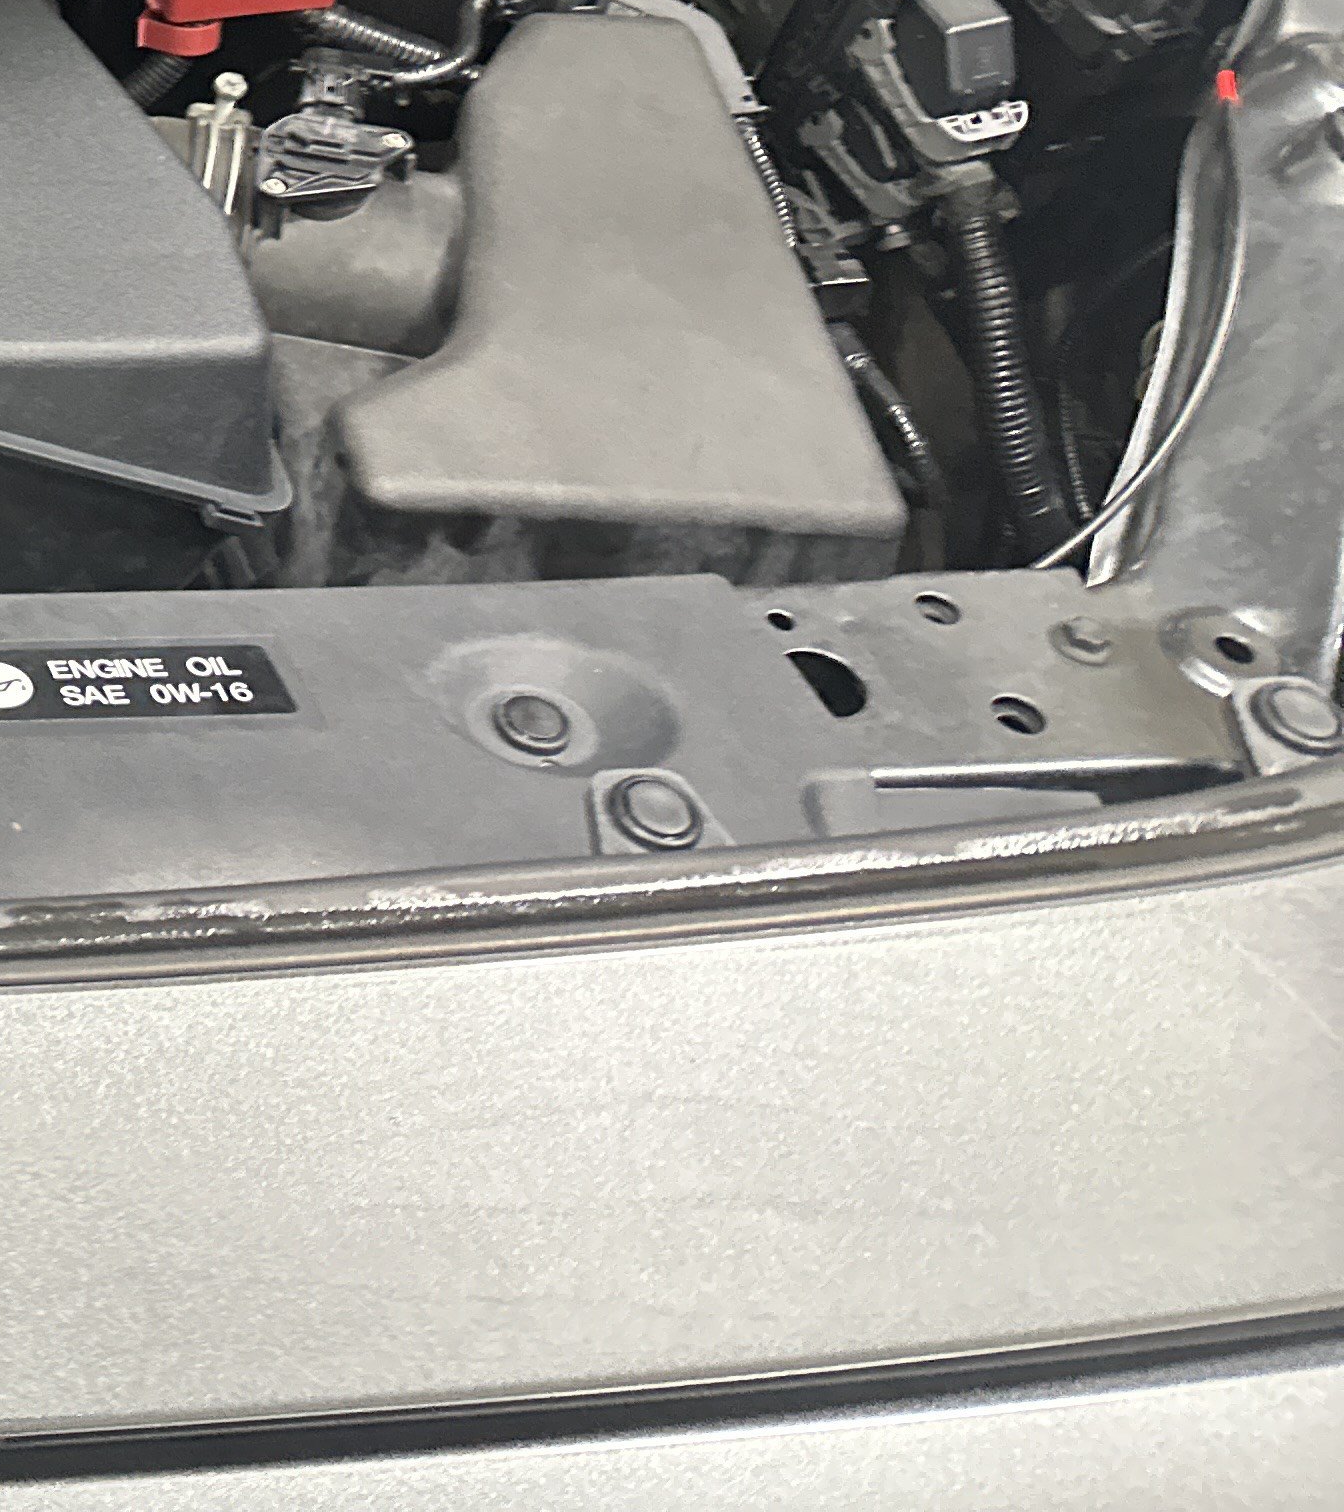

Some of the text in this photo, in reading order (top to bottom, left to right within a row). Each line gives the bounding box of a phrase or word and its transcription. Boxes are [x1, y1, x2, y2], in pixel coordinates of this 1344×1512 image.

[46, 656, 243, 681] ENGINE OIL
[59, 682, 254, 707] SAE 0W-16
